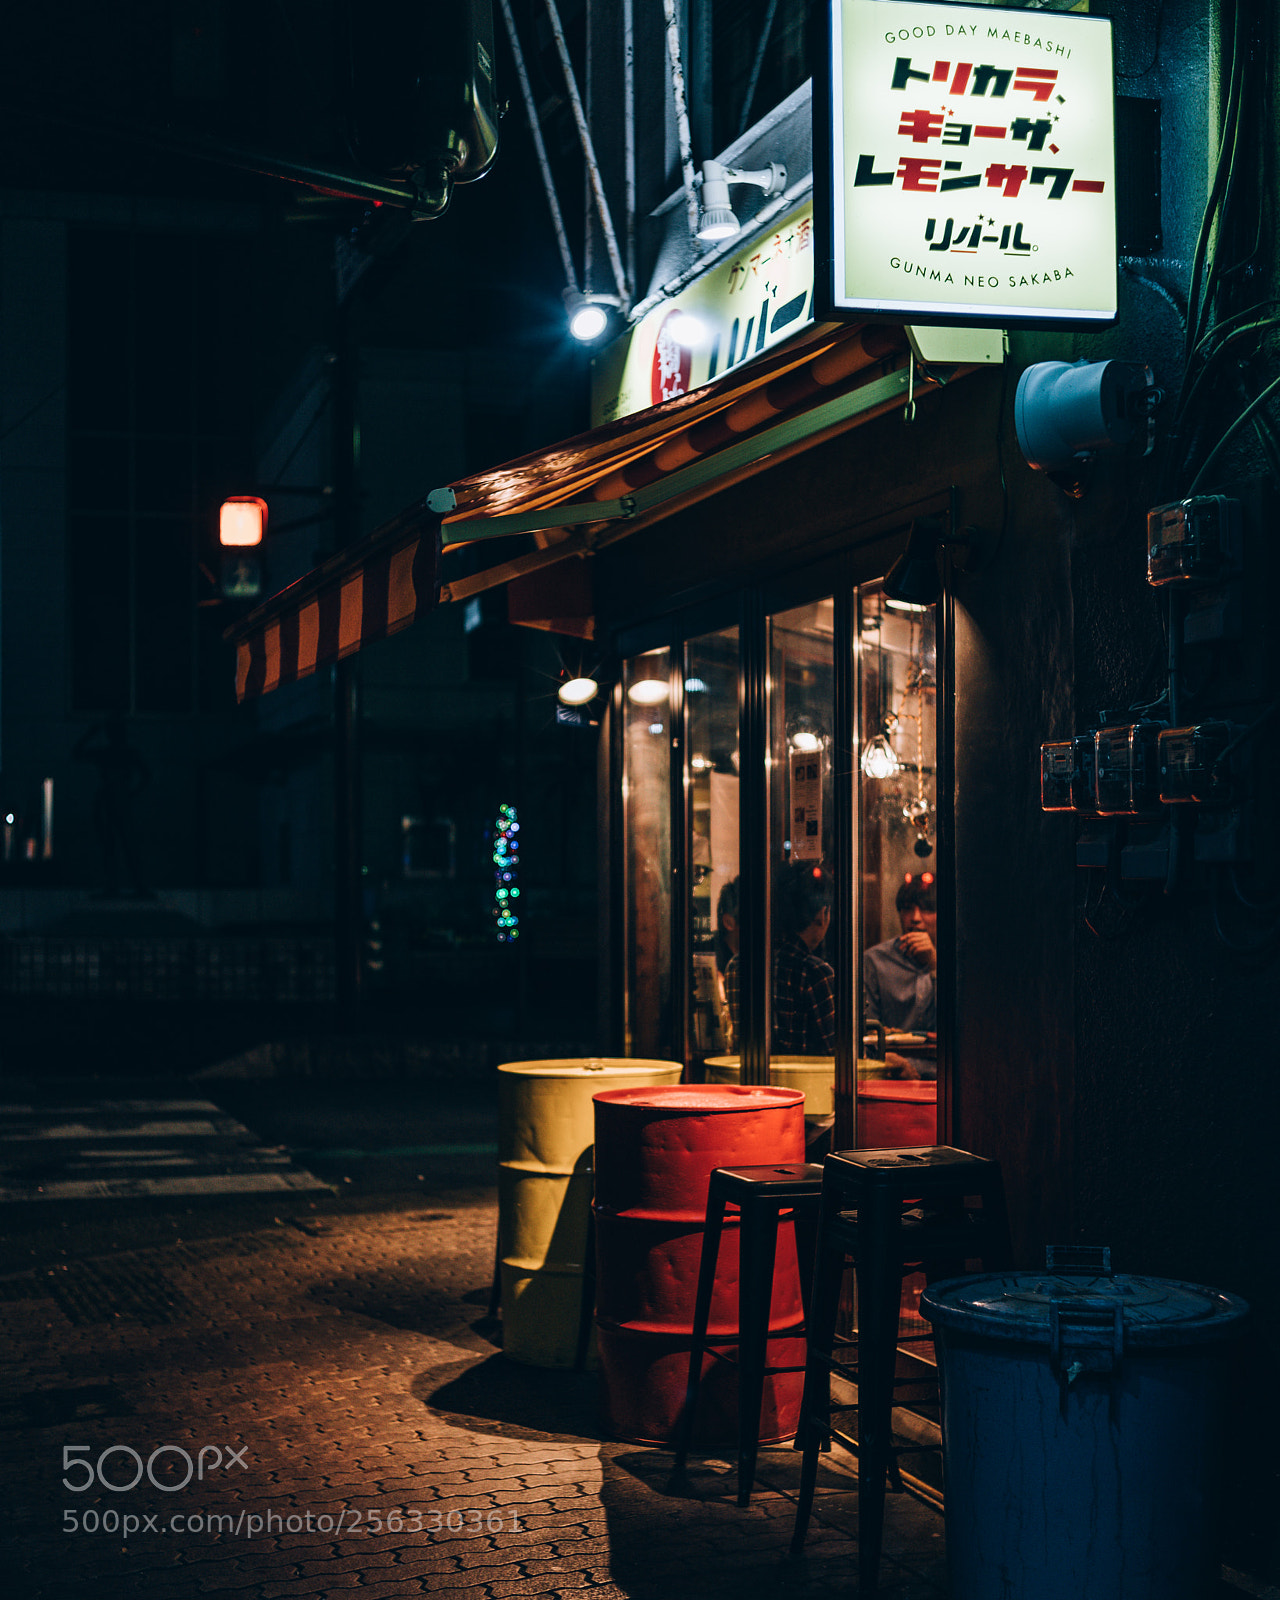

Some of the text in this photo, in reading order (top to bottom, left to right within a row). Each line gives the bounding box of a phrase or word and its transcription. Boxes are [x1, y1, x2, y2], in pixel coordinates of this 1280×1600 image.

[885, 24, 1072, 59] GOOD DAY MAEBASHI
[854, 154, 1105, 200] レモンサワー
[890, 257, 1075, 288] GUNMA NEO SAKABA
